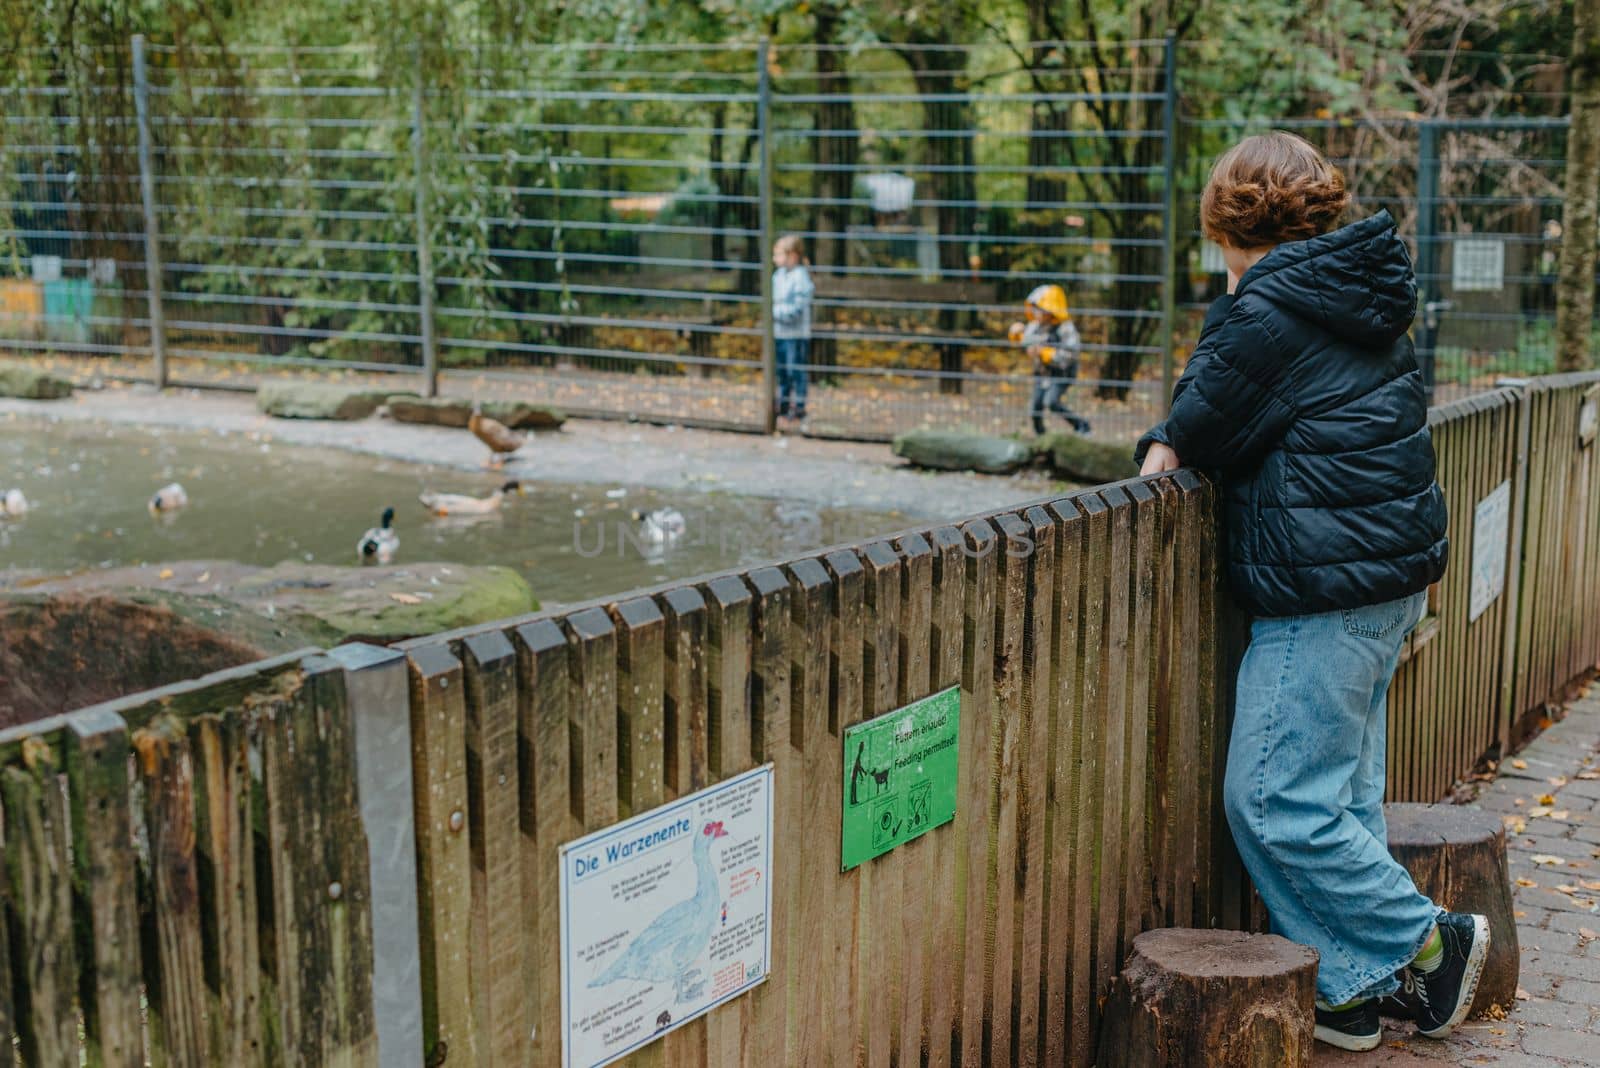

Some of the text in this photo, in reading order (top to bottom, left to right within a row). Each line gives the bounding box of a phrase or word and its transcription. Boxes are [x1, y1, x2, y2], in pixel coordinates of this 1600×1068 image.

[895, 750, 922, 770] Feeding
[576, 854, 599, 877] Die
[606, 819, 690, 863] Warzenente
